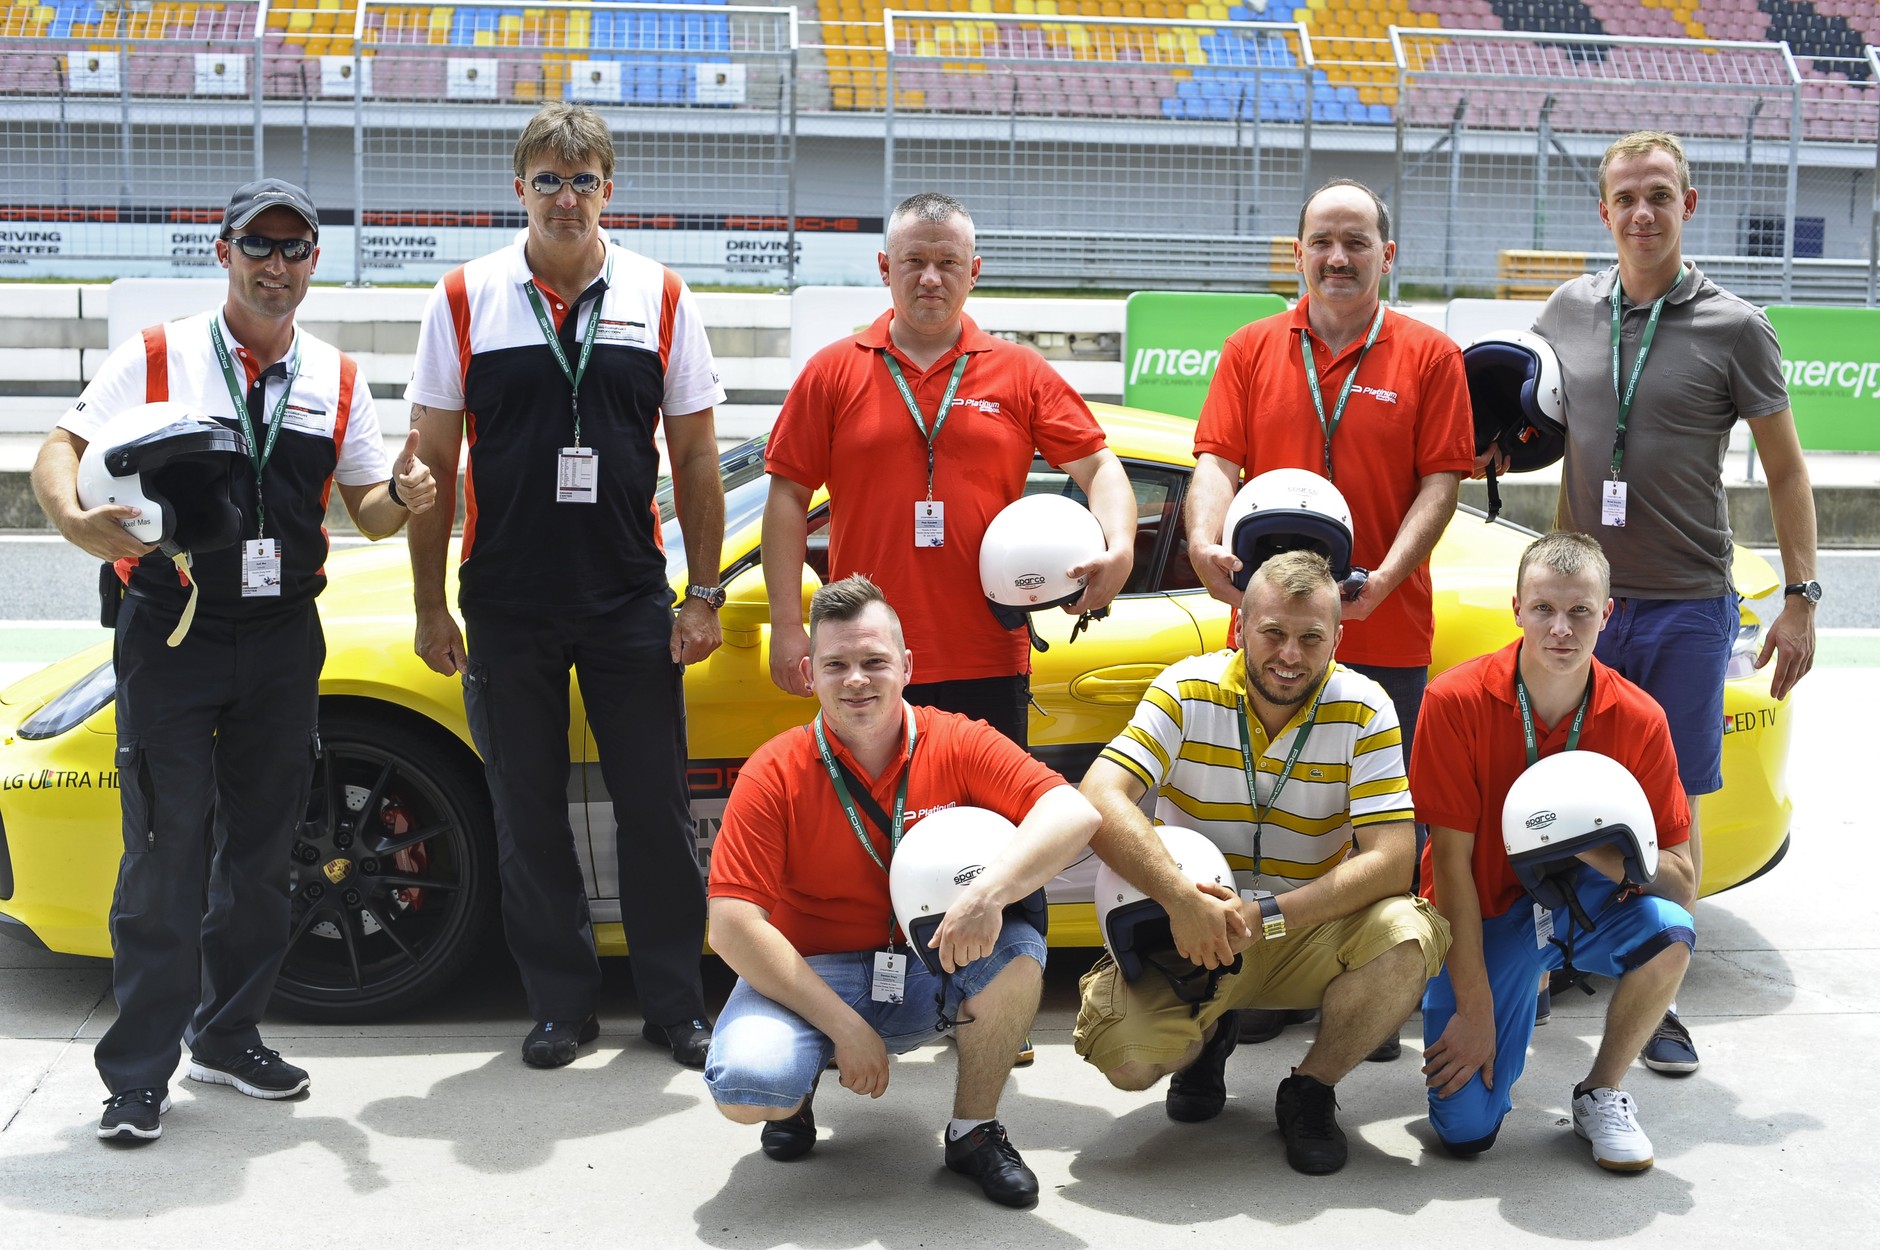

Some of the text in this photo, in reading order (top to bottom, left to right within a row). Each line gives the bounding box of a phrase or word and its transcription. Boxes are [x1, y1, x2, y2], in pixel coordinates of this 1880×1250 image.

[361, 235, 437, 246] DRIVING
[725, 215, 858, 231] PORSCHE
[726, 240, 802, 251] DRIVING
[726, 253, 800, 265] CENTER
[540, 316, 569, 374] PORSCHE
[580, 312, 600, 370] PORSCHE
[895, 374, 925, 428] PORSCHE
[936, 376, 959, 429] PORSCHE
[1308, 368, 1325, 423] PORSCHE
[1363, 387, 1398, 398] Platinum
[1624, 346, 1647, 406] PORSCHE
[233, 395, 255, 457] PORSCHE
[263, 398, 286, 457] PORSCHE
[965, 399, 1000, 409] Platinum
[122, 520, 136, 528] Axel
[1014, 576, 1046, 588] sparco
[1518, 683, 1534, 749] PORSCHE
[1723, 707, 1776, 736] LED TV
[816, 719, 839, 779] PORSCHE
[4, 773, 25, 791] LG
[28, 768, 92, 790] ULTRA
[1242, 743, 1257, 809] PORSCHE
[1267, 748, 1299, 809] PORSCHE
[846, 806, 883, 868] PORSCHE
[1525, 812, 1557, 829] sparco
